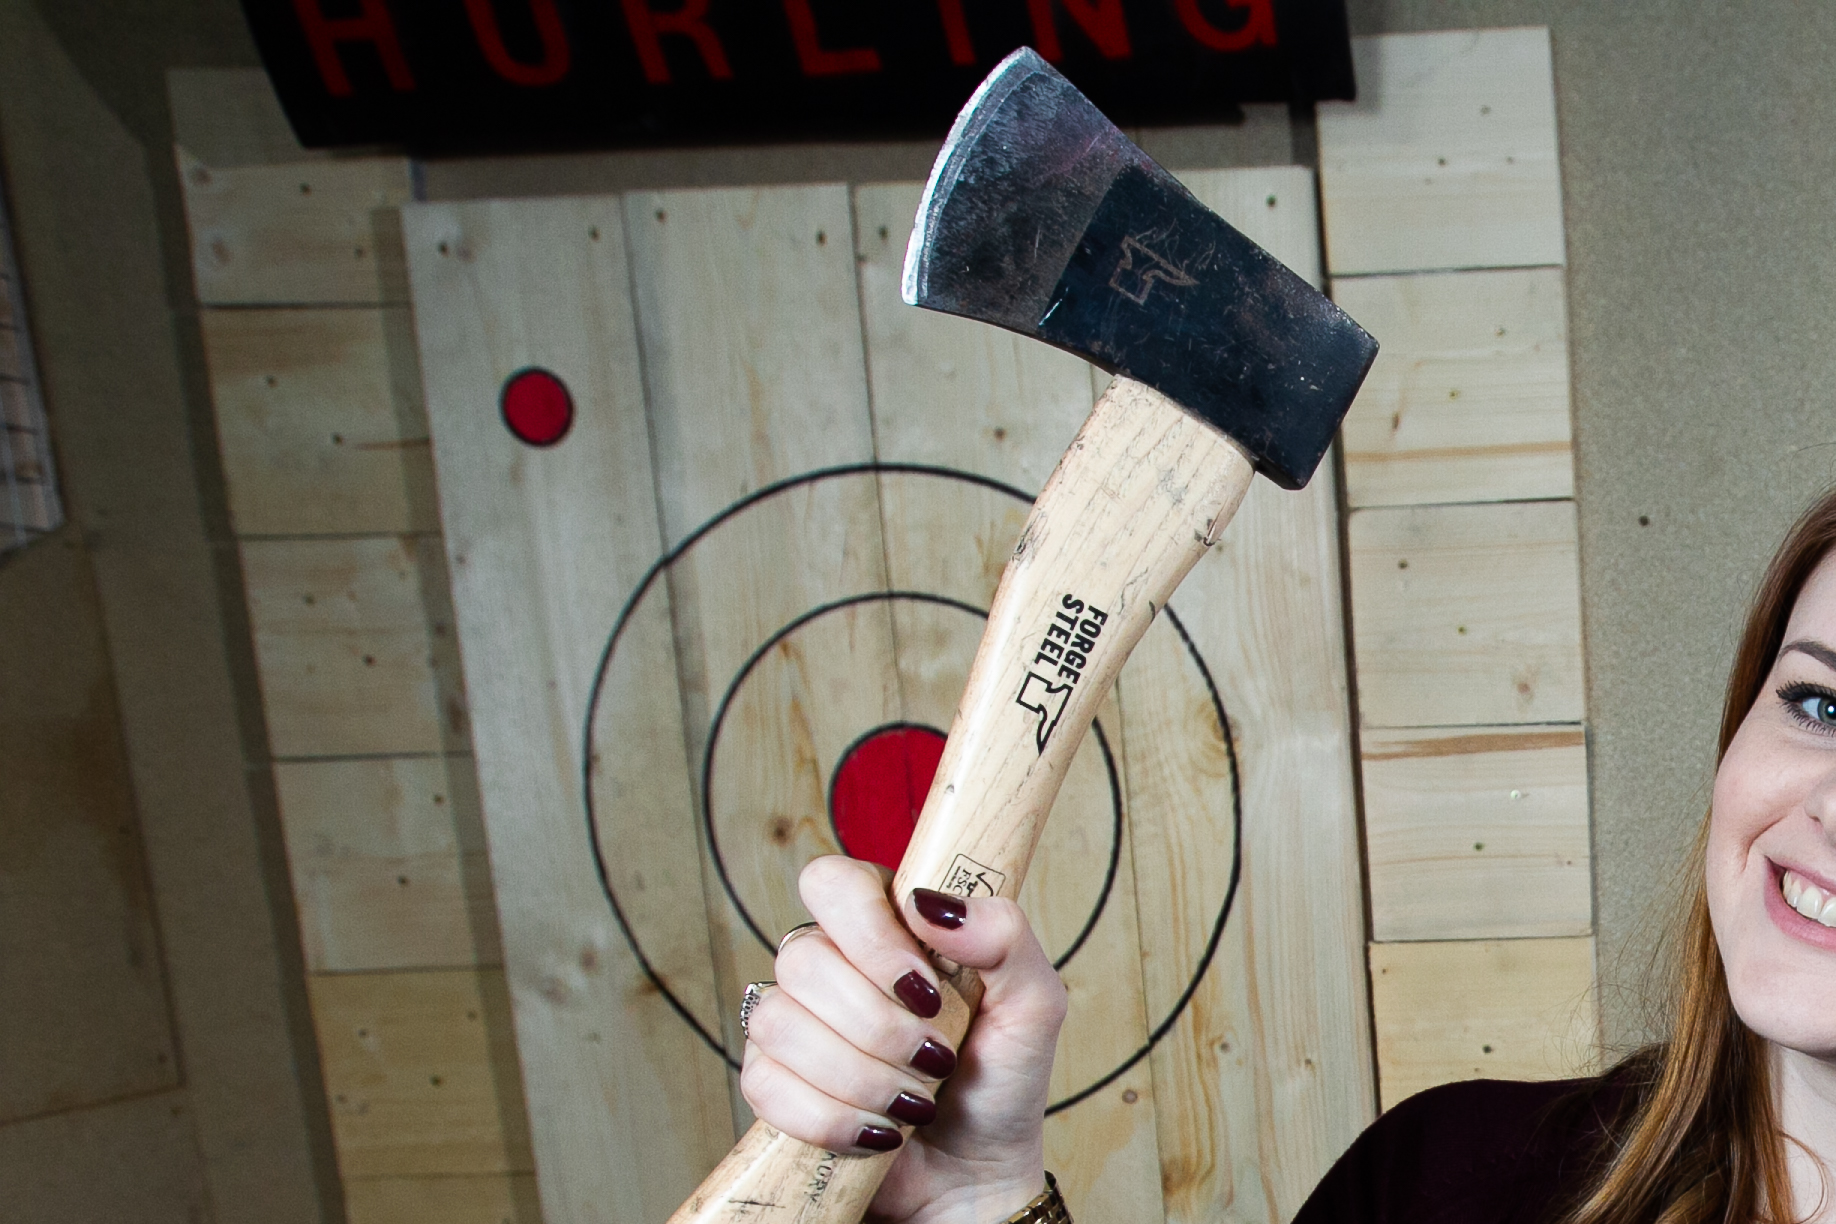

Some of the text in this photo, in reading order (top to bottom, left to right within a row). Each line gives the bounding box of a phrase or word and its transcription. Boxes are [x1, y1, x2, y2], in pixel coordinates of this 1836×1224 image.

[289, 0, 1278, 98] HURLING
[1034, 594, 1085, 666] STEEL
[1057, 605, 1109, 684] FORGE
[952, 868, 972, 896] FSC
